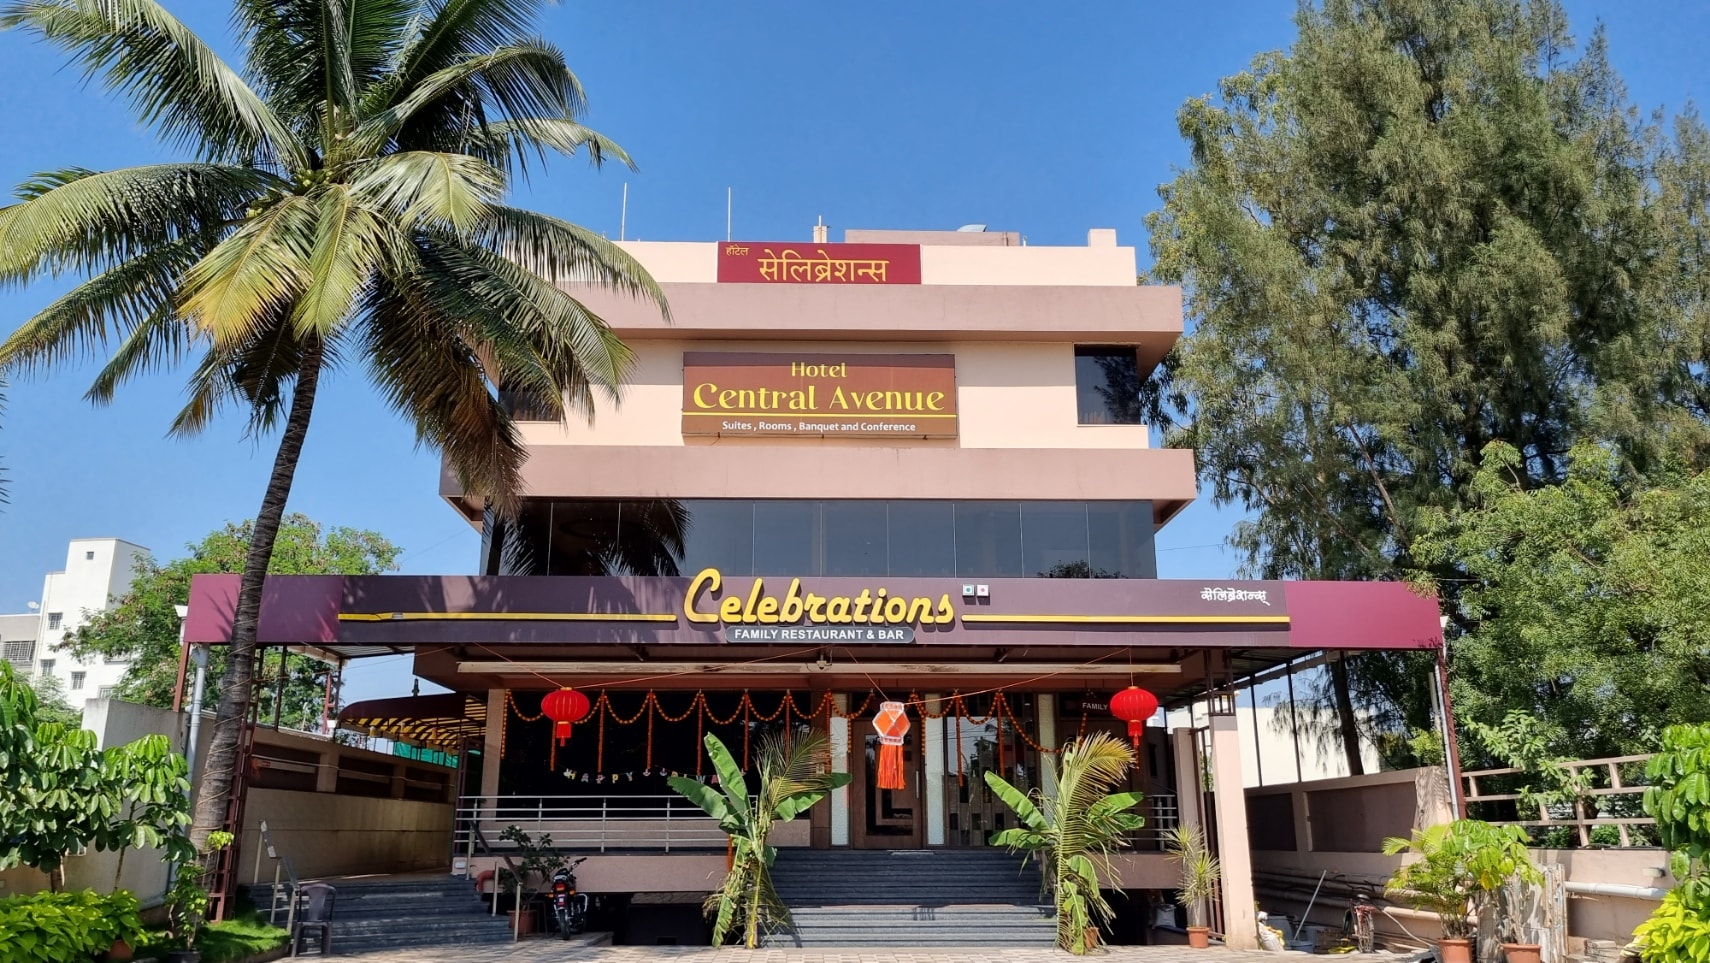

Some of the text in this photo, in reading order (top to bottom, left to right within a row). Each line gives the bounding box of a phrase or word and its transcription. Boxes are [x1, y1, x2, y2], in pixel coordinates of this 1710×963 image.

[757, 248, 890, 283] सेलिब्रेशन्स
[791, 361, 848, 378] Hotel
[693, 383, 945, 411] Central Avenue
[799, 422, 839, 433] Banquet
[840, 422, 859, 431] and
[861, 422, 916, 432] Conference
[683, 567, 955, 624] Celebrations
[734, 628, 904, 640] FAMILY RESTAURANT & BAR
[1082, 702, 1108, 710] FAMILY
